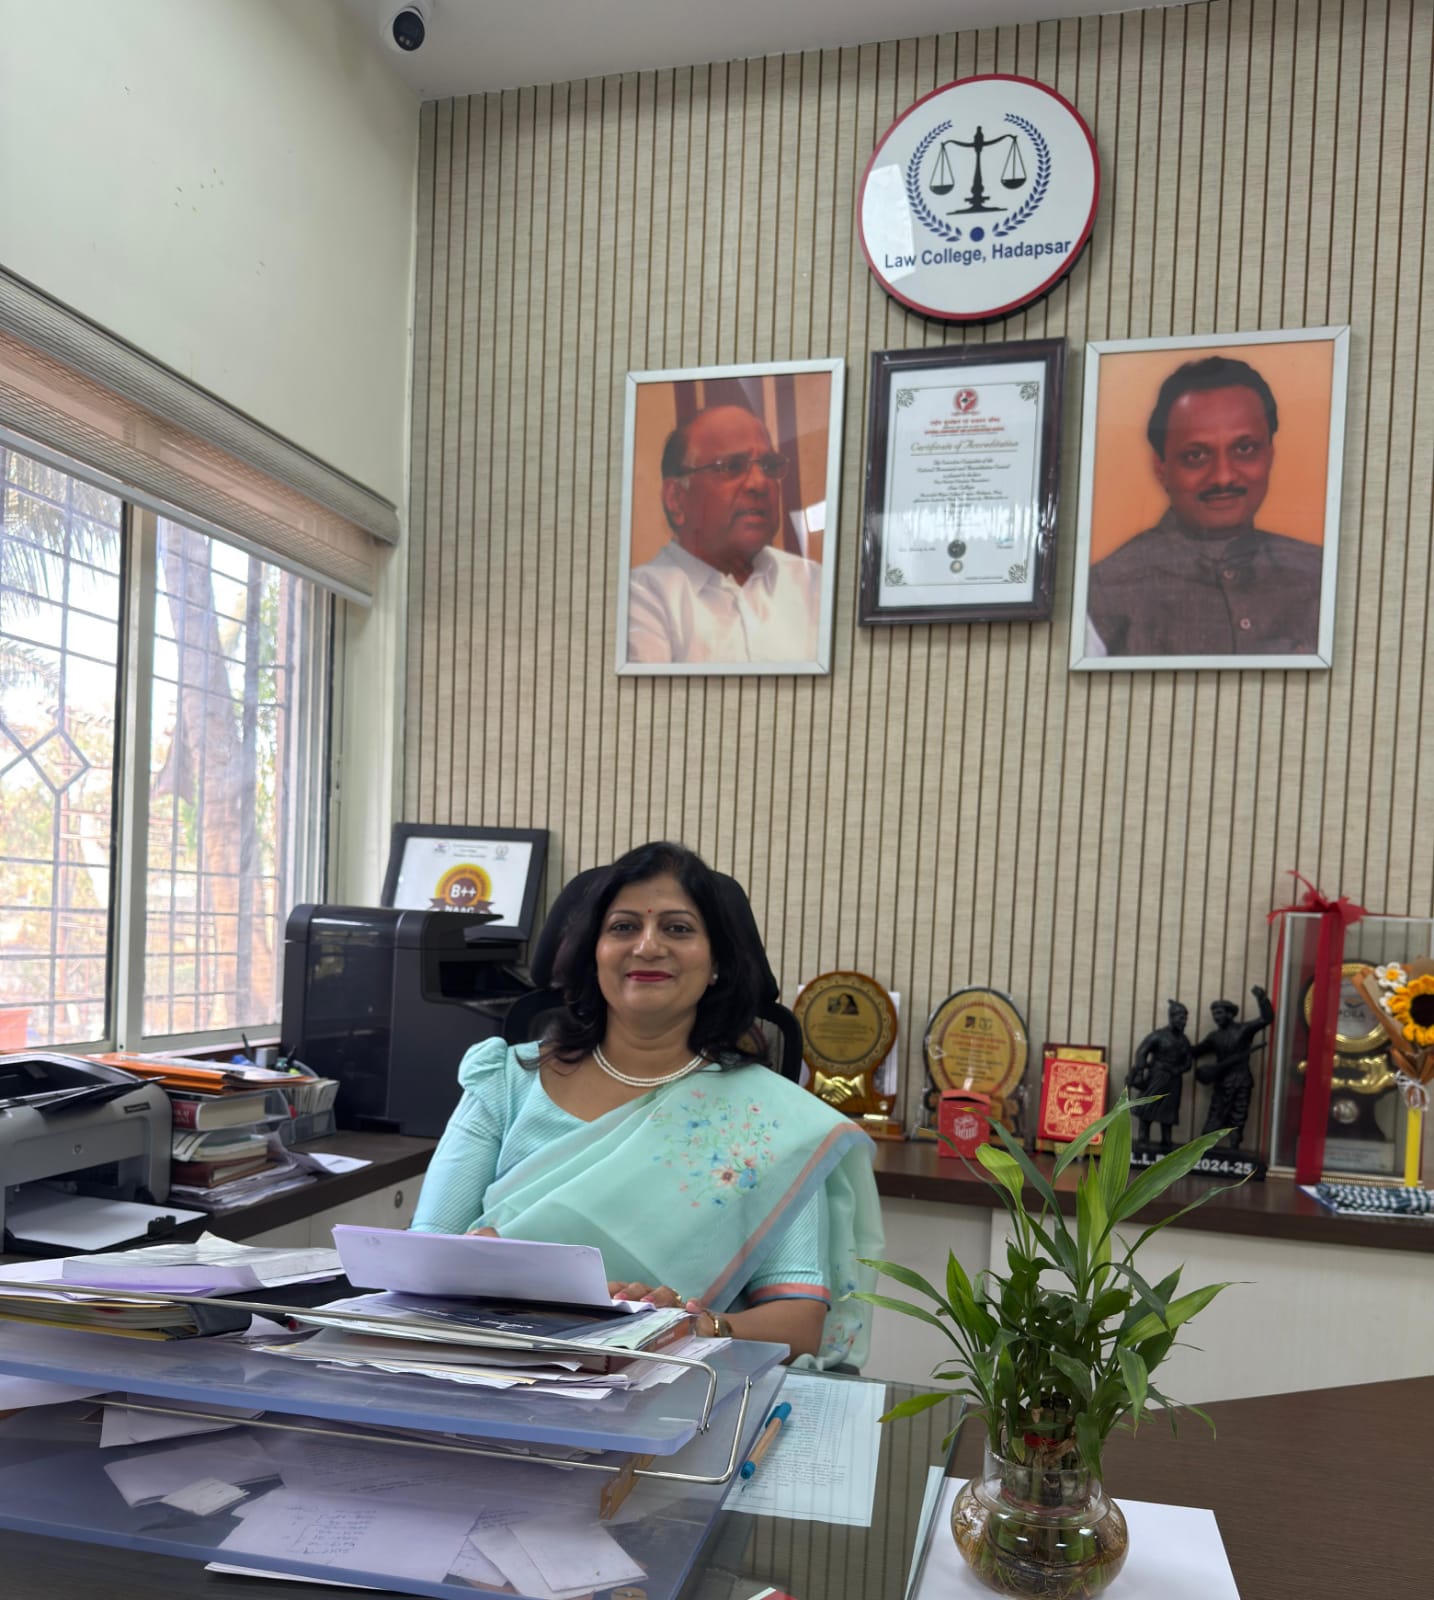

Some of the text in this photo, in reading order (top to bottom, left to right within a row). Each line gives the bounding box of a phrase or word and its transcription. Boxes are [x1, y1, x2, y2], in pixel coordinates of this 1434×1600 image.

[884, 239, 1072, 268] Law College, Hadapsar
[452, 884, 476, 898] B++
